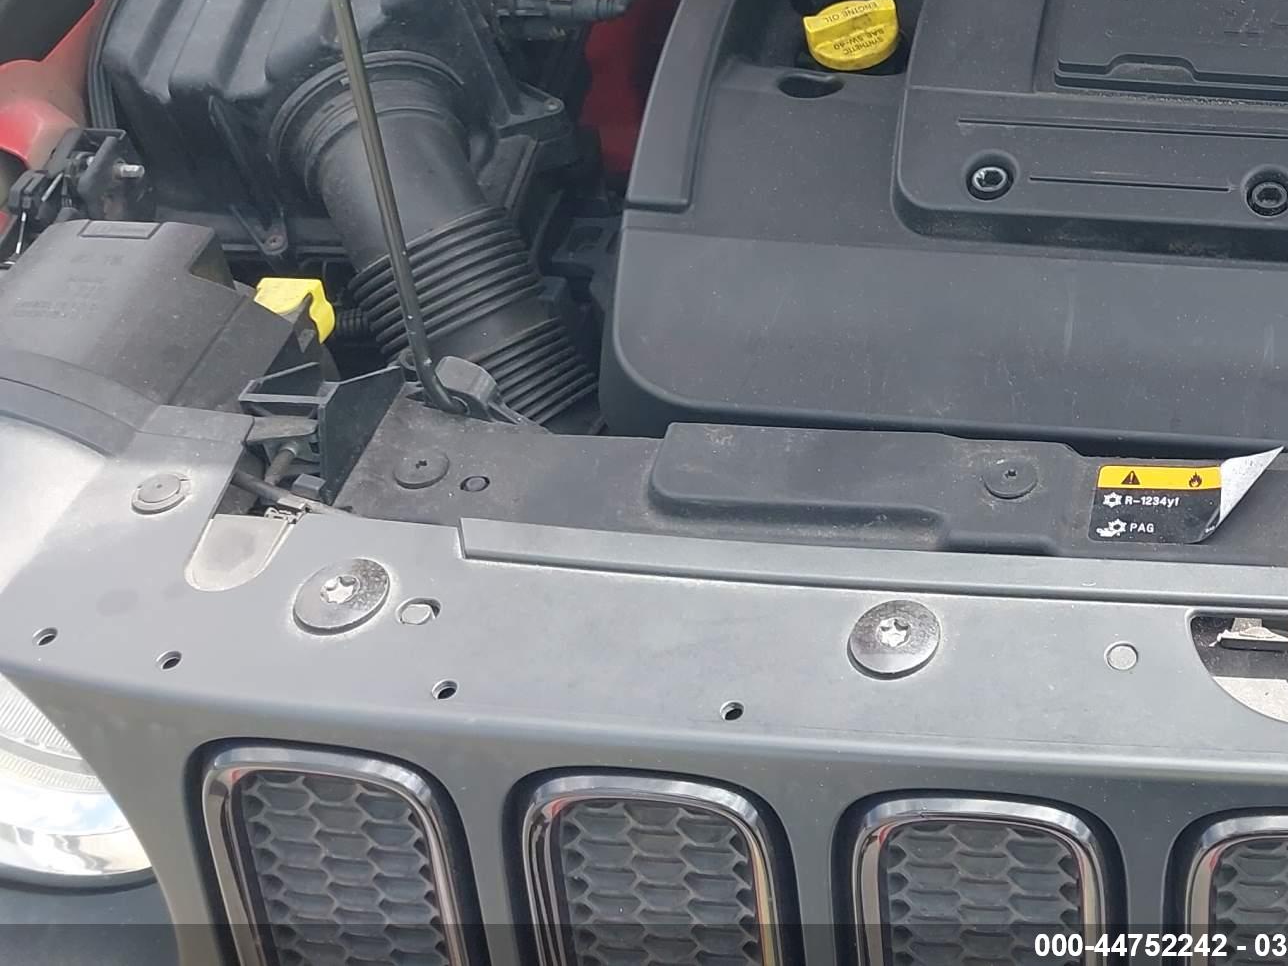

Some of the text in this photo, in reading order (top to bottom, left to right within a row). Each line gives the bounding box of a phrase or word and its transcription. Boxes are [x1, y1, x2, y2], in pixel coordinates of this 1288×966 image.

[824, 2, 878, 24] ENGINE OIL
[843, 37, 884, 55] SYNTHETIC
[1124, 495, 1180, 508] R-1234yf
[1129, 522, 1155, 534] PAG
